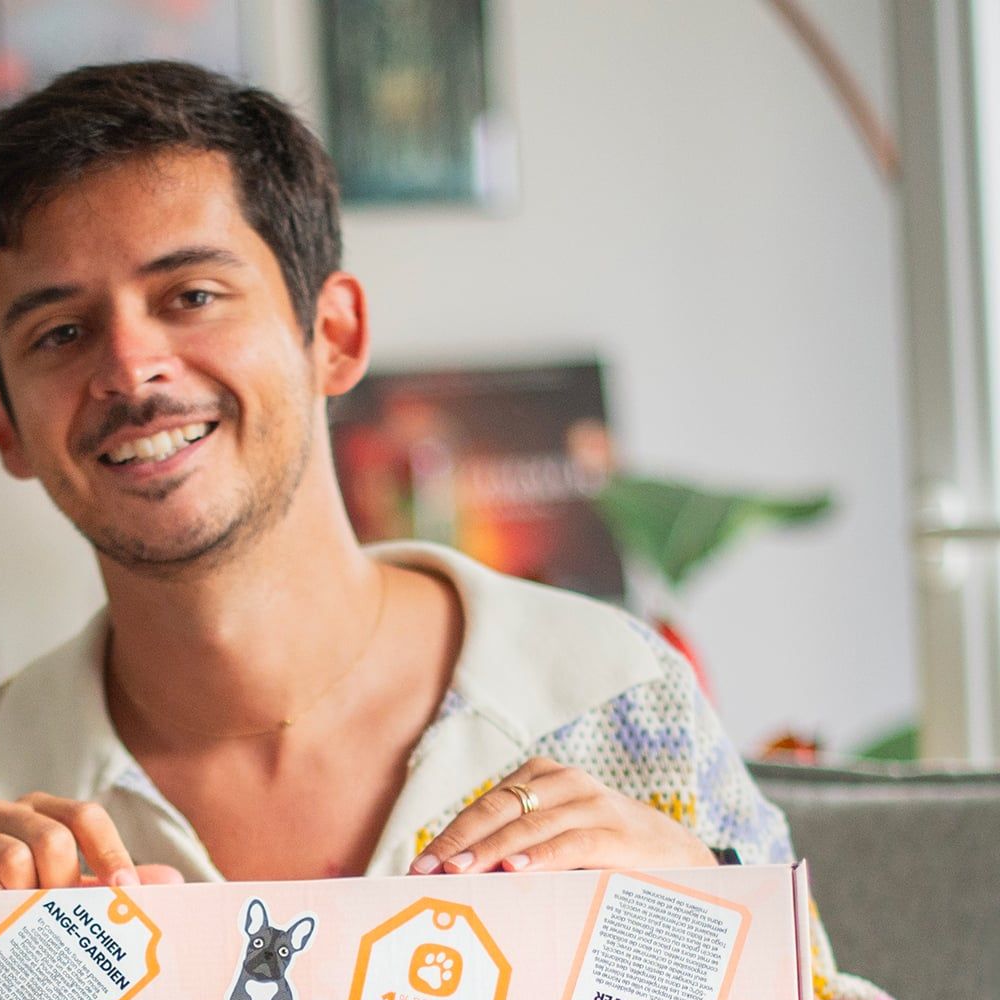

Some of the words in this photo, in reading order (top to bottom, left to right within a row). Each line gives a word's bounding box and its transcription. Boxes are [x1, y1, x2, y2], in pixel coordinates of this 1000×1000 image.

[43, 901, 130, 990] ANGE-GARDIEN
[73, 904, 93, 926] UN
[89, 923, 126, 961] CHIEN
